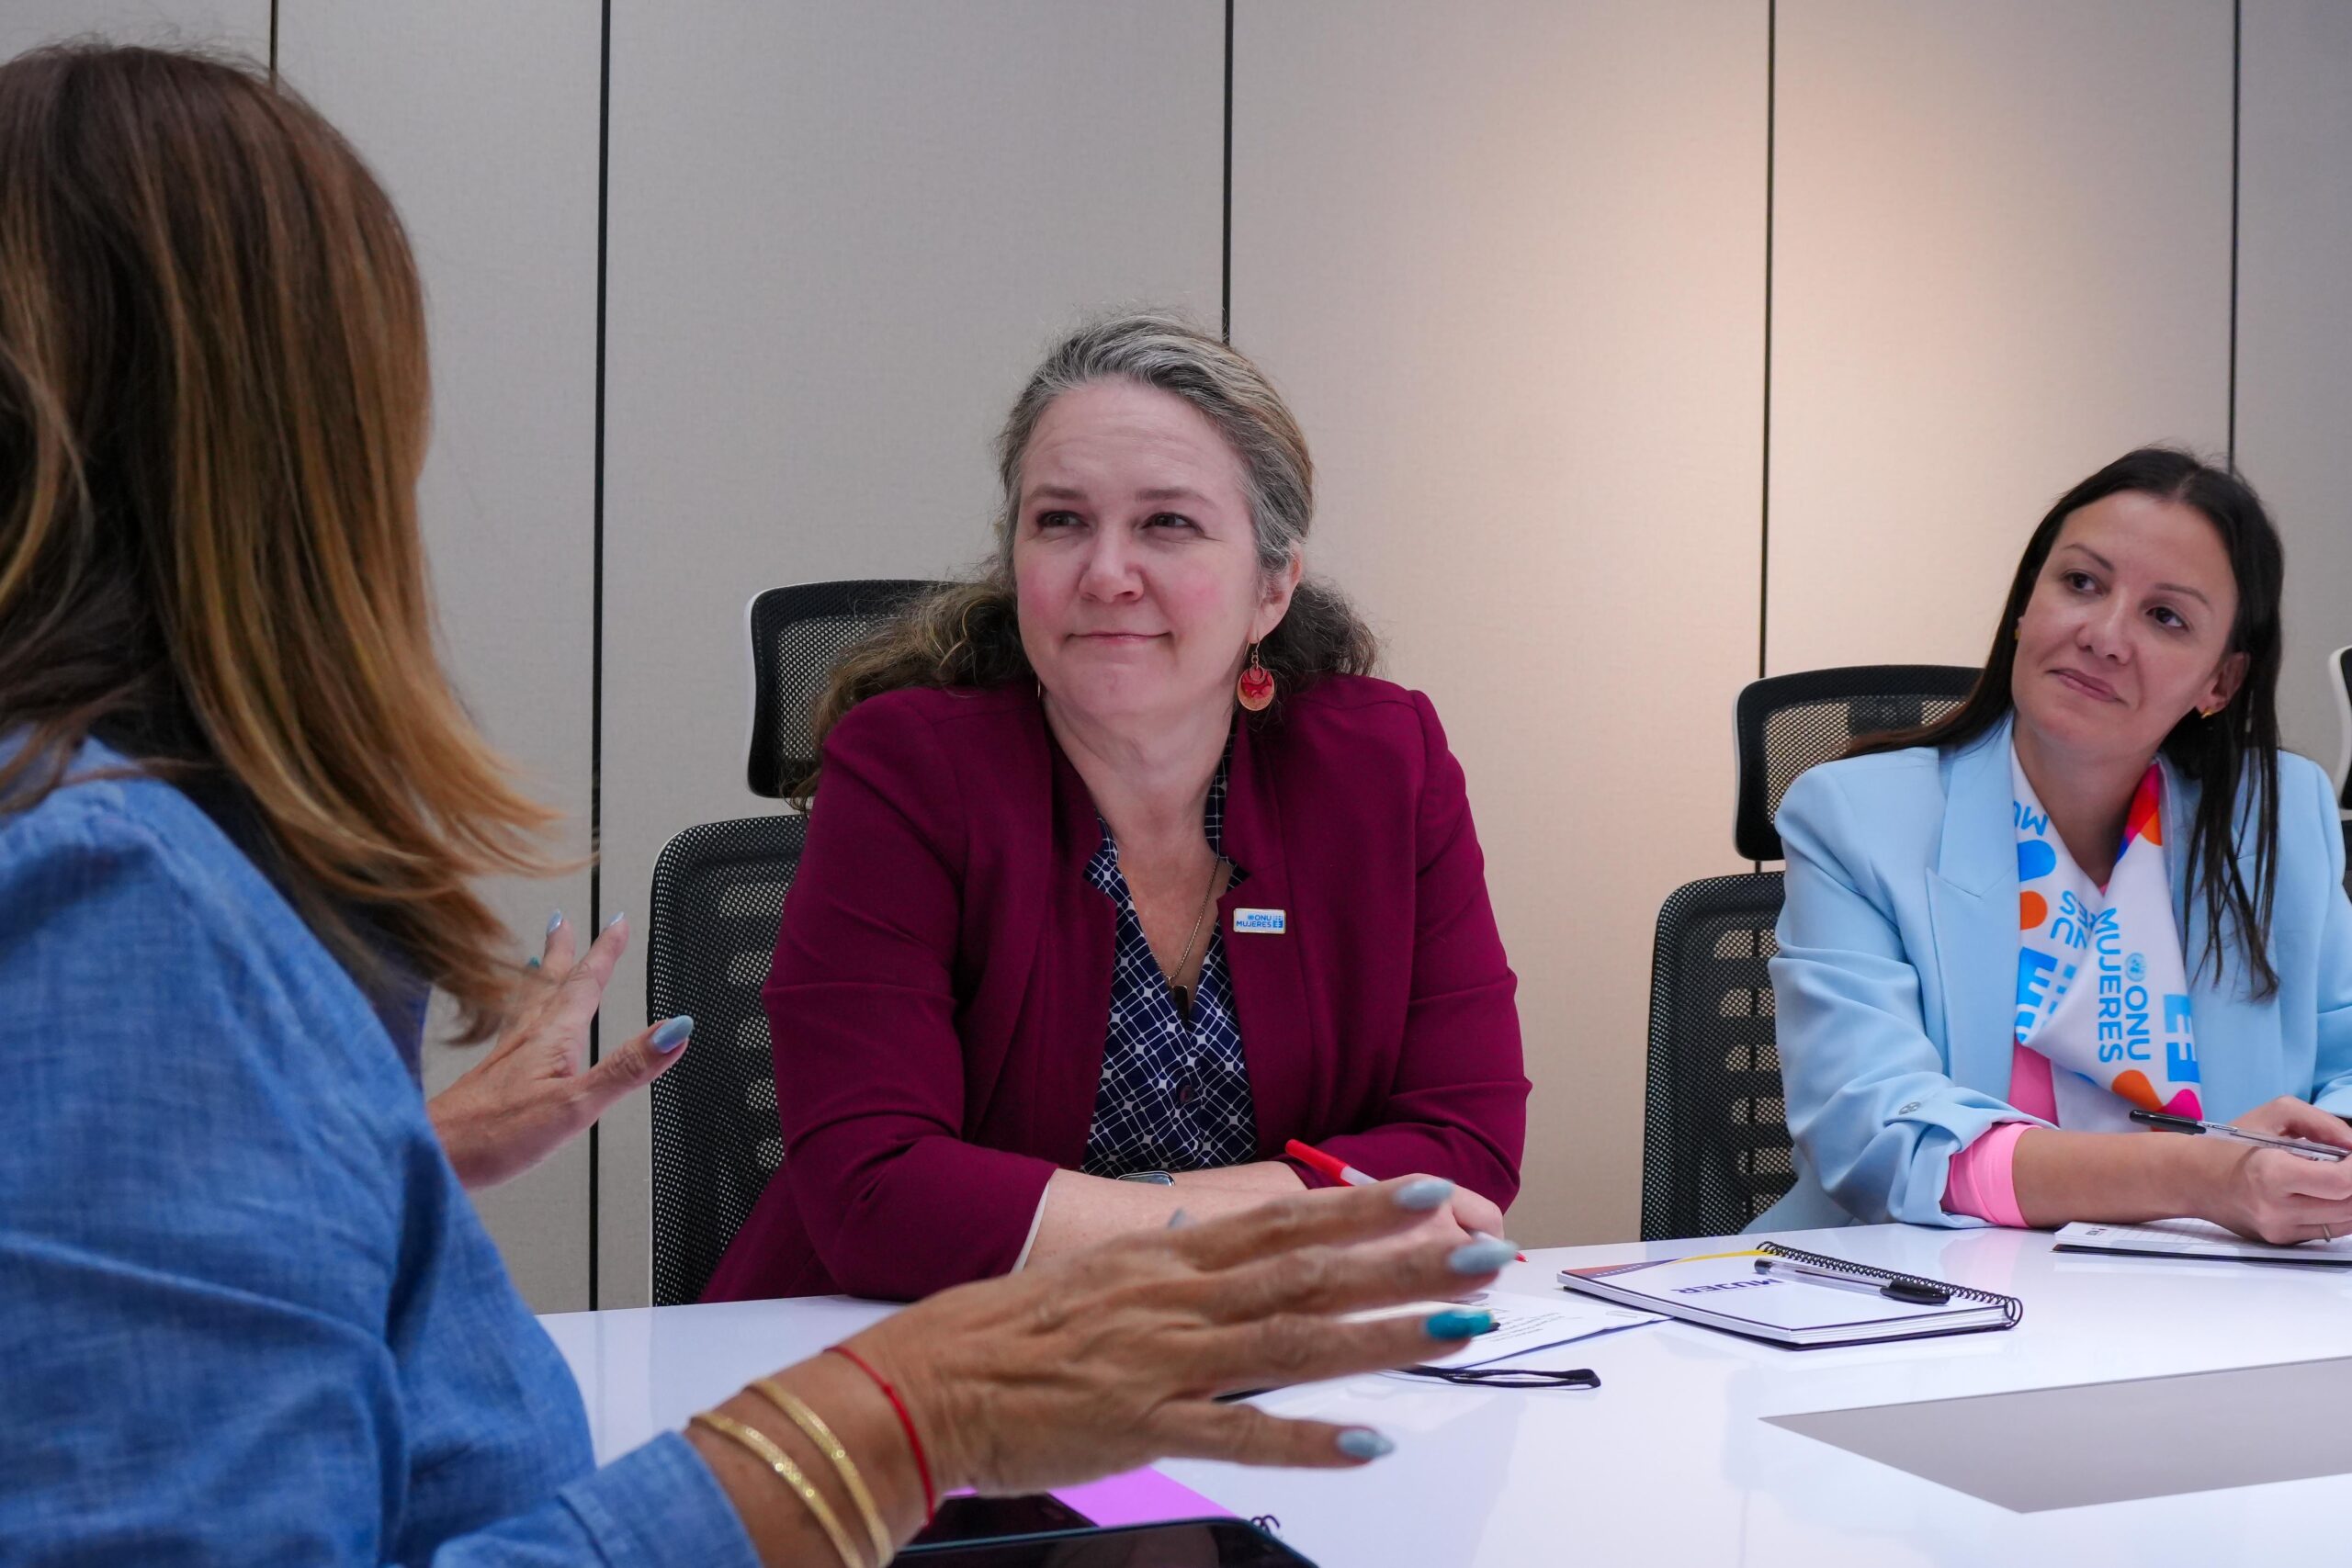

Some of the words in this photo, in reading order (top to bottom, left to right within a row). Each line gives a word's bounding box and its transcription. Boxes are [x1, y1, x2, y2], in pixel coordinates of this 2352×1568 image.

[2094, 908, 2124, 1064] MUJERES
[2124, 985, 2151, 1061] ONU
[1670, 1278, 1783, 1294] MUJER
